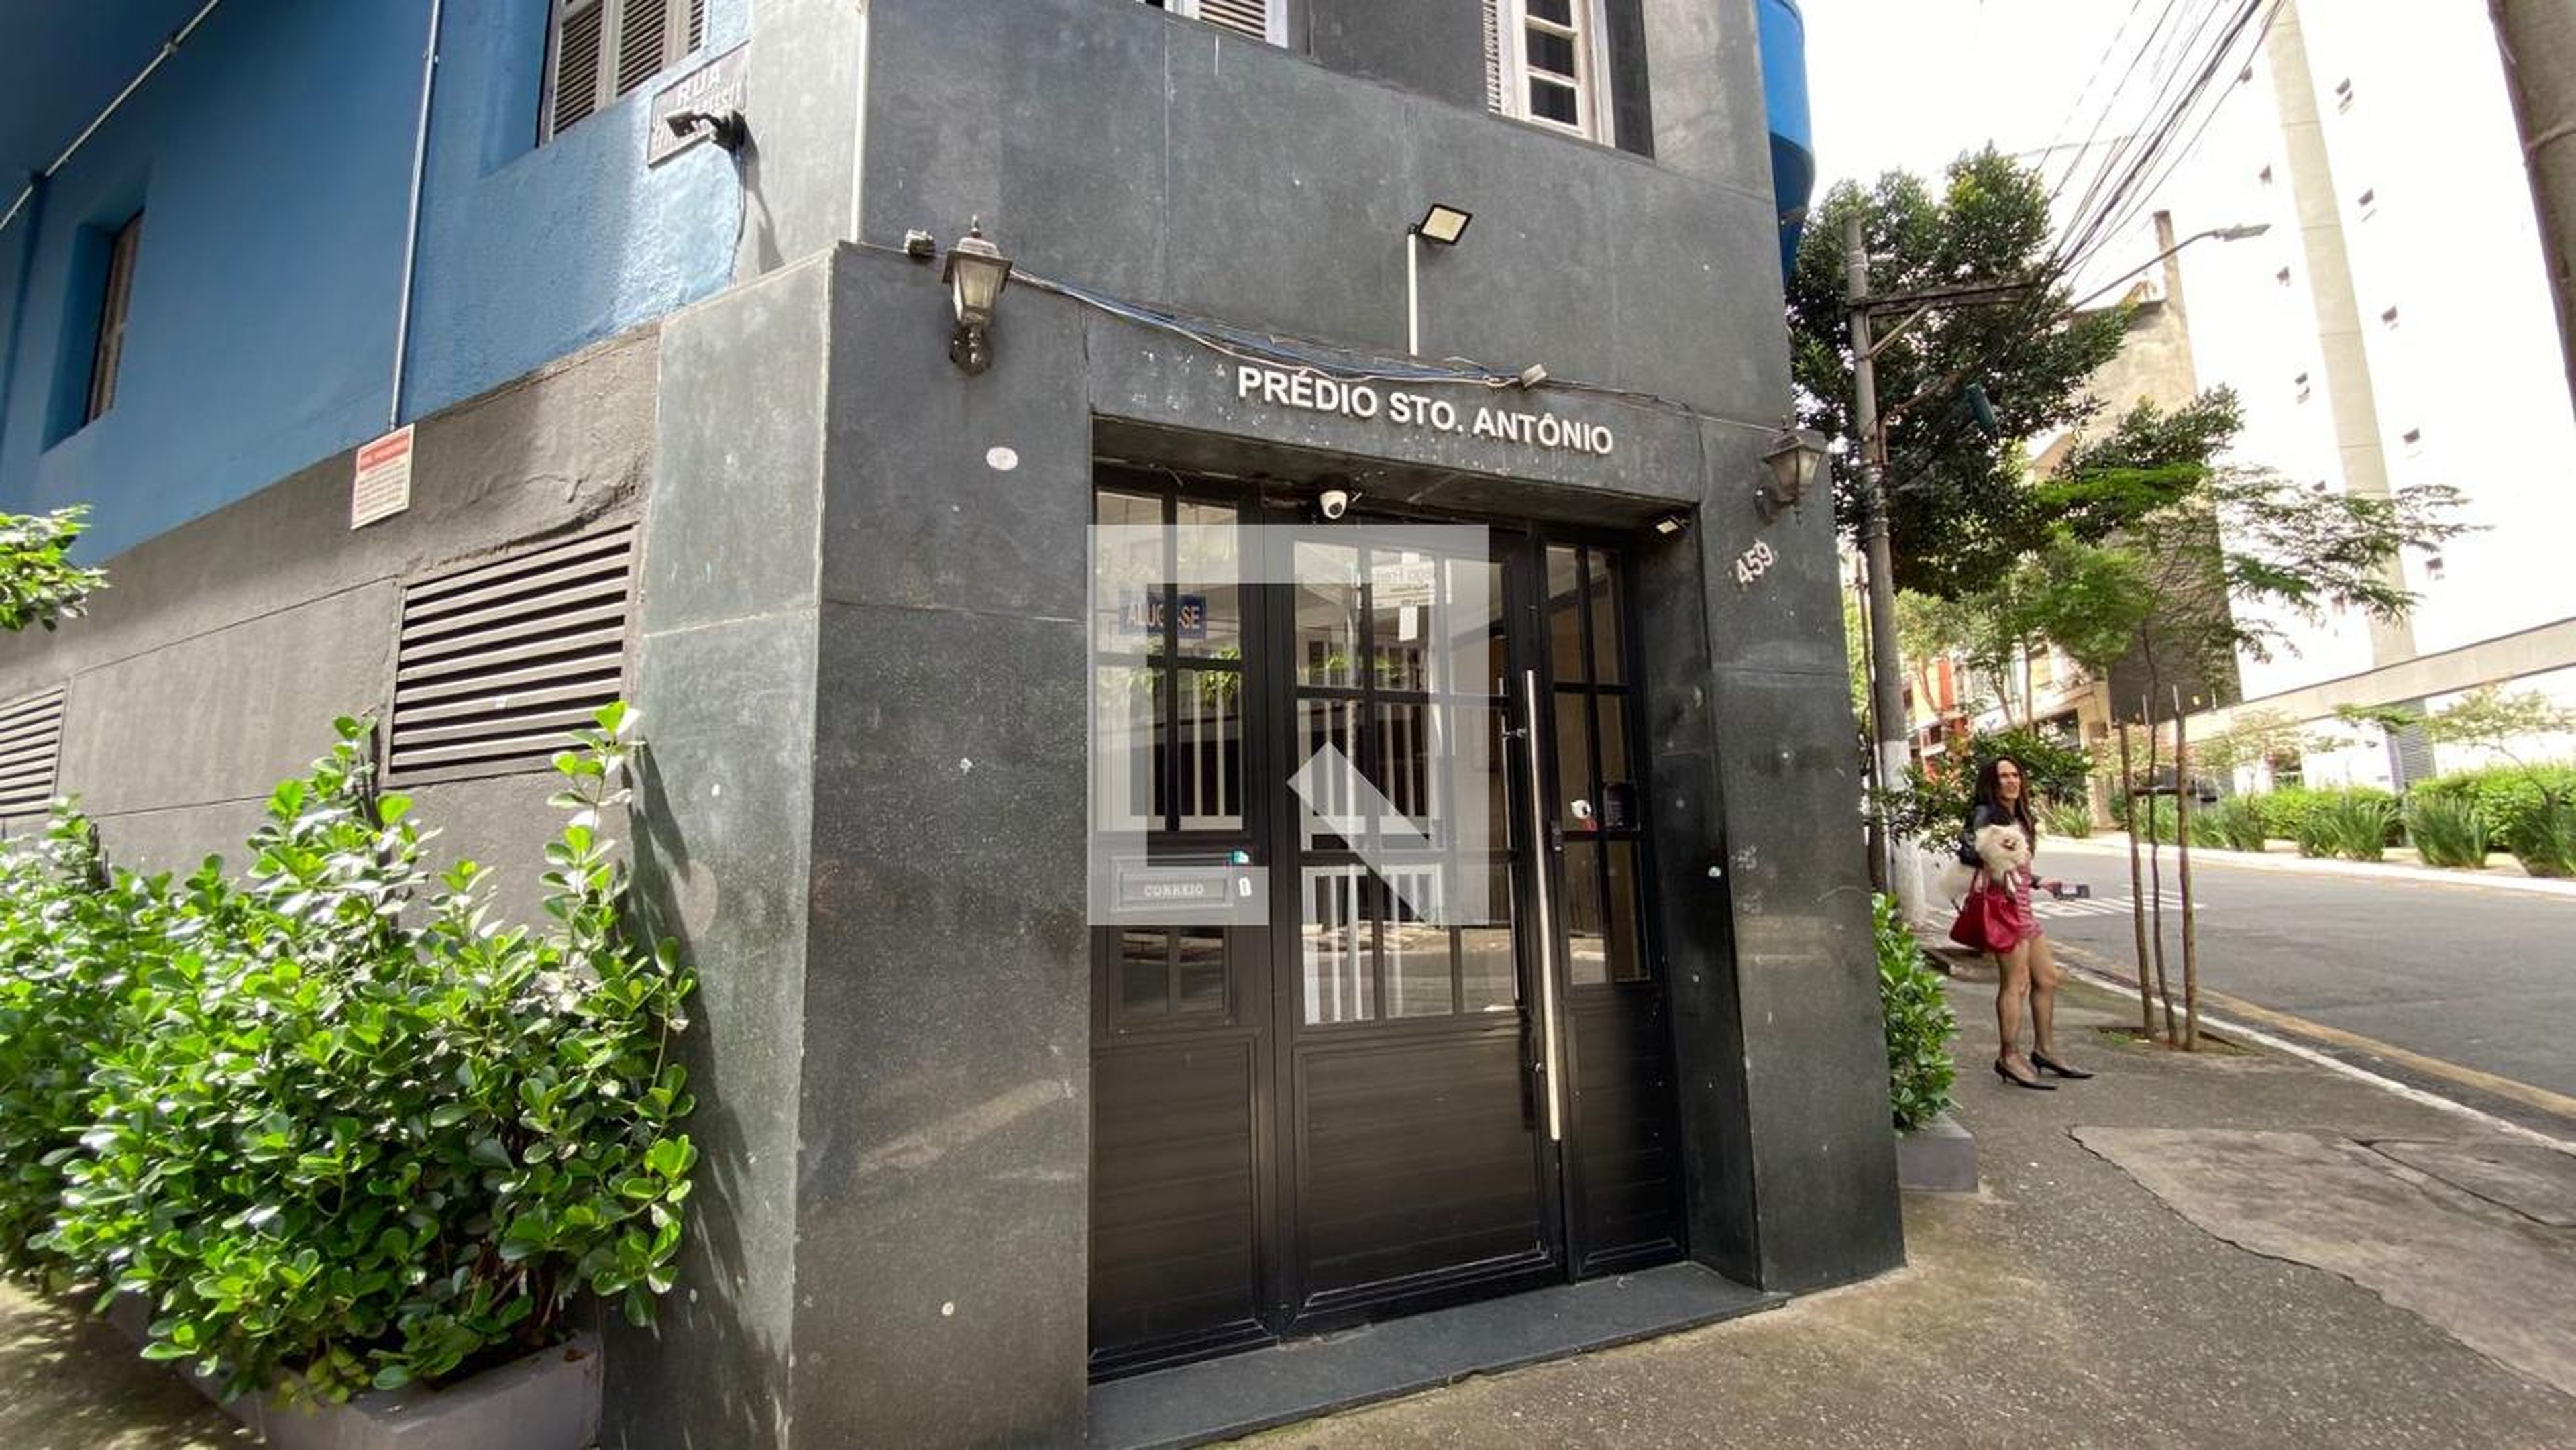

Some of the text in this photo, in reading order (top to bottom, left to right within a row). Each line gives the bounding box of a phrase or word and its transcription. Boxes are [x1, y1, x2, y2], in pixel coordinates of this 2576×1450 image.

[678, 69, 720, 106] RUA
[1238, 366, 1613, 454] PRÉDIO STO. ANTÔNIO
[1736, 541, 1773, 583] 459
[1144, 882, 1204, 896] CORREIO
